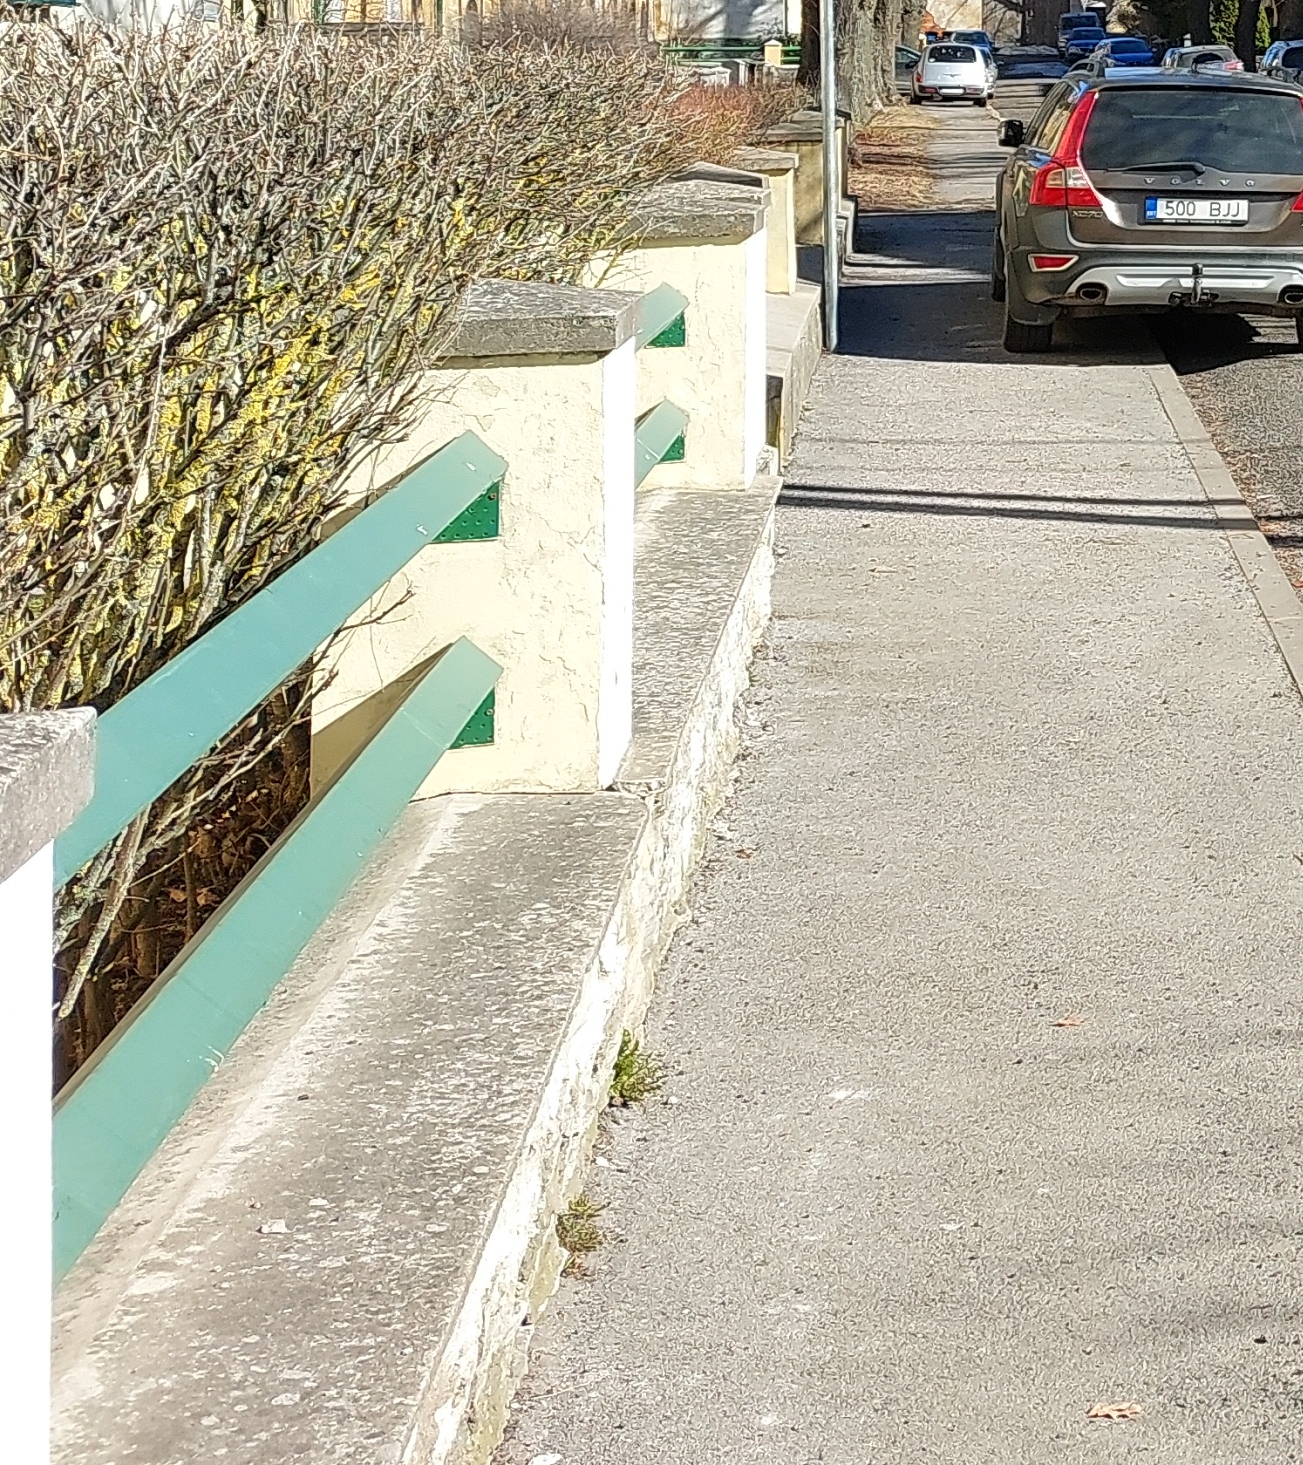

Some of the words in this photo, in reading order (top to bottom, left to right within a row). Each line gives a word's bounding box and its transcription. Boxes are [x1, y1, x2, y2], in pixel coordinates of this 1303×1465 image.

[1143, 177, 1256, 188] VOLVO
[1164, 200, 1197, 217] 500
[1209, 201, 1240, 218] BJJ
